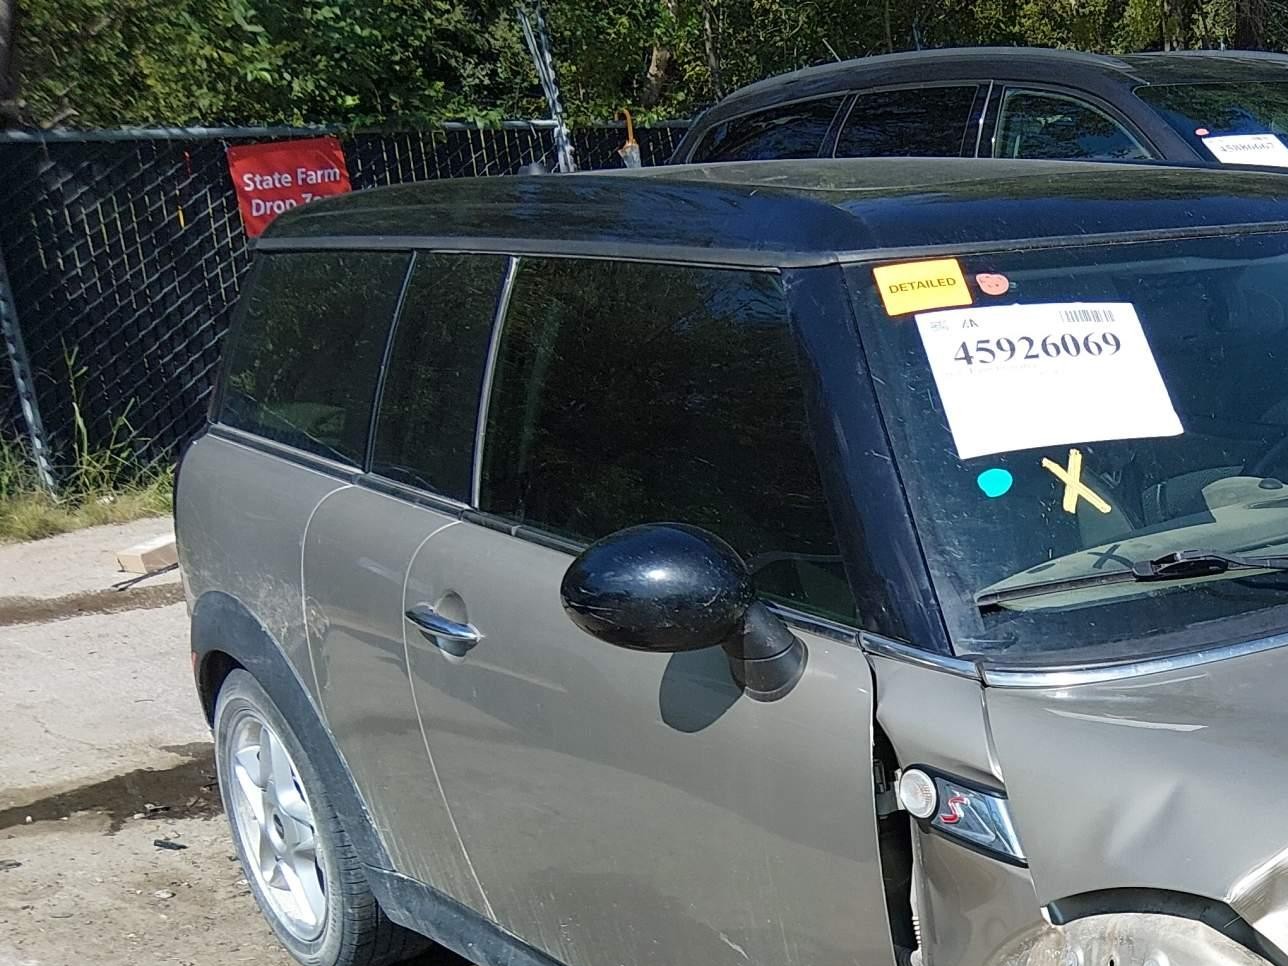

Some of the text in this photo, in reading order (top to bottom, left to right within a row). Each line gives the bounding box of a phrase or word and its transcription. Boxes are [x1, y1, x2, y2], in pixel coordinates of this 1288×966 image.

[242, 167, 340, 192] State Farm
[888, 276, 957, 295] DETAILED
[953, 331, 1122, 366] 45926069
